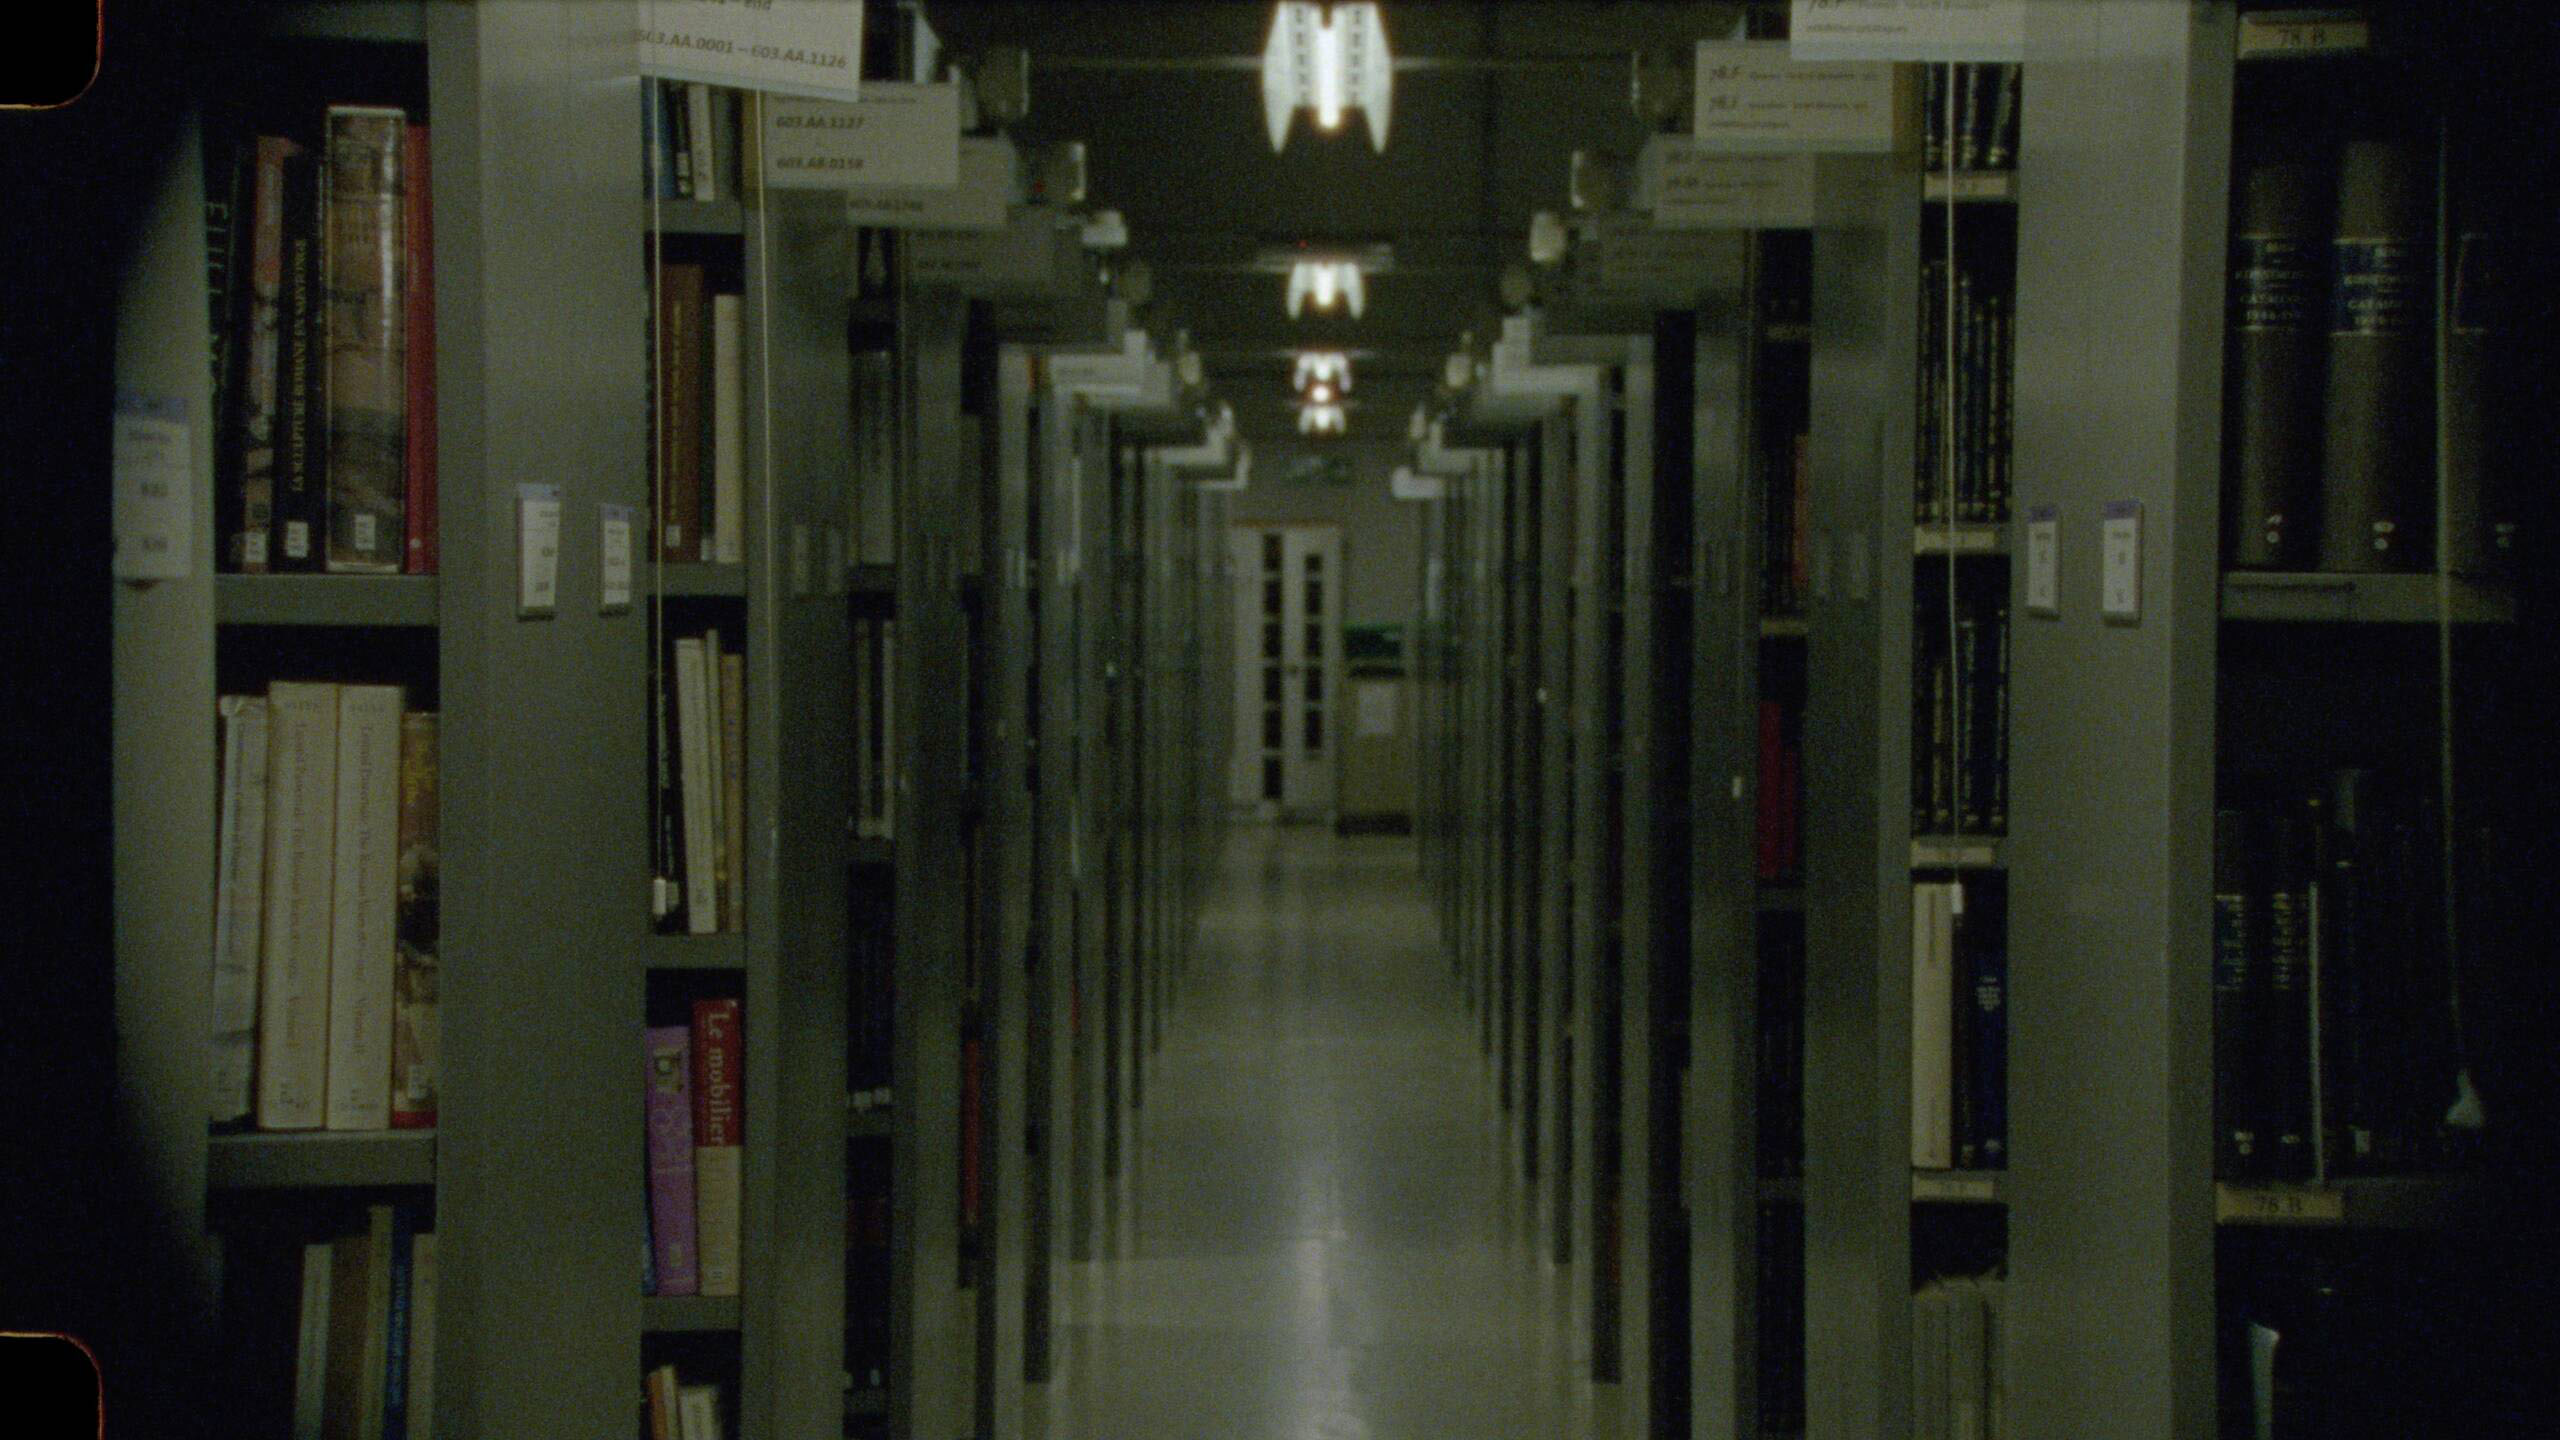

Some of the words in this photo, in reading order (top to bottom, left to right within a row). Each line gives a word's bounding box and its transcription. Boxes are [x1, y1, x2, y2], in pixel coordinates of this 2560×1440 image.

[292, 340, 306, 396] ROMANE
[292, 399, 306, 474] SCULPTURE
[708, 1012, 731, 1039] Le
[708, 1047, 733, 1145] mobilier
